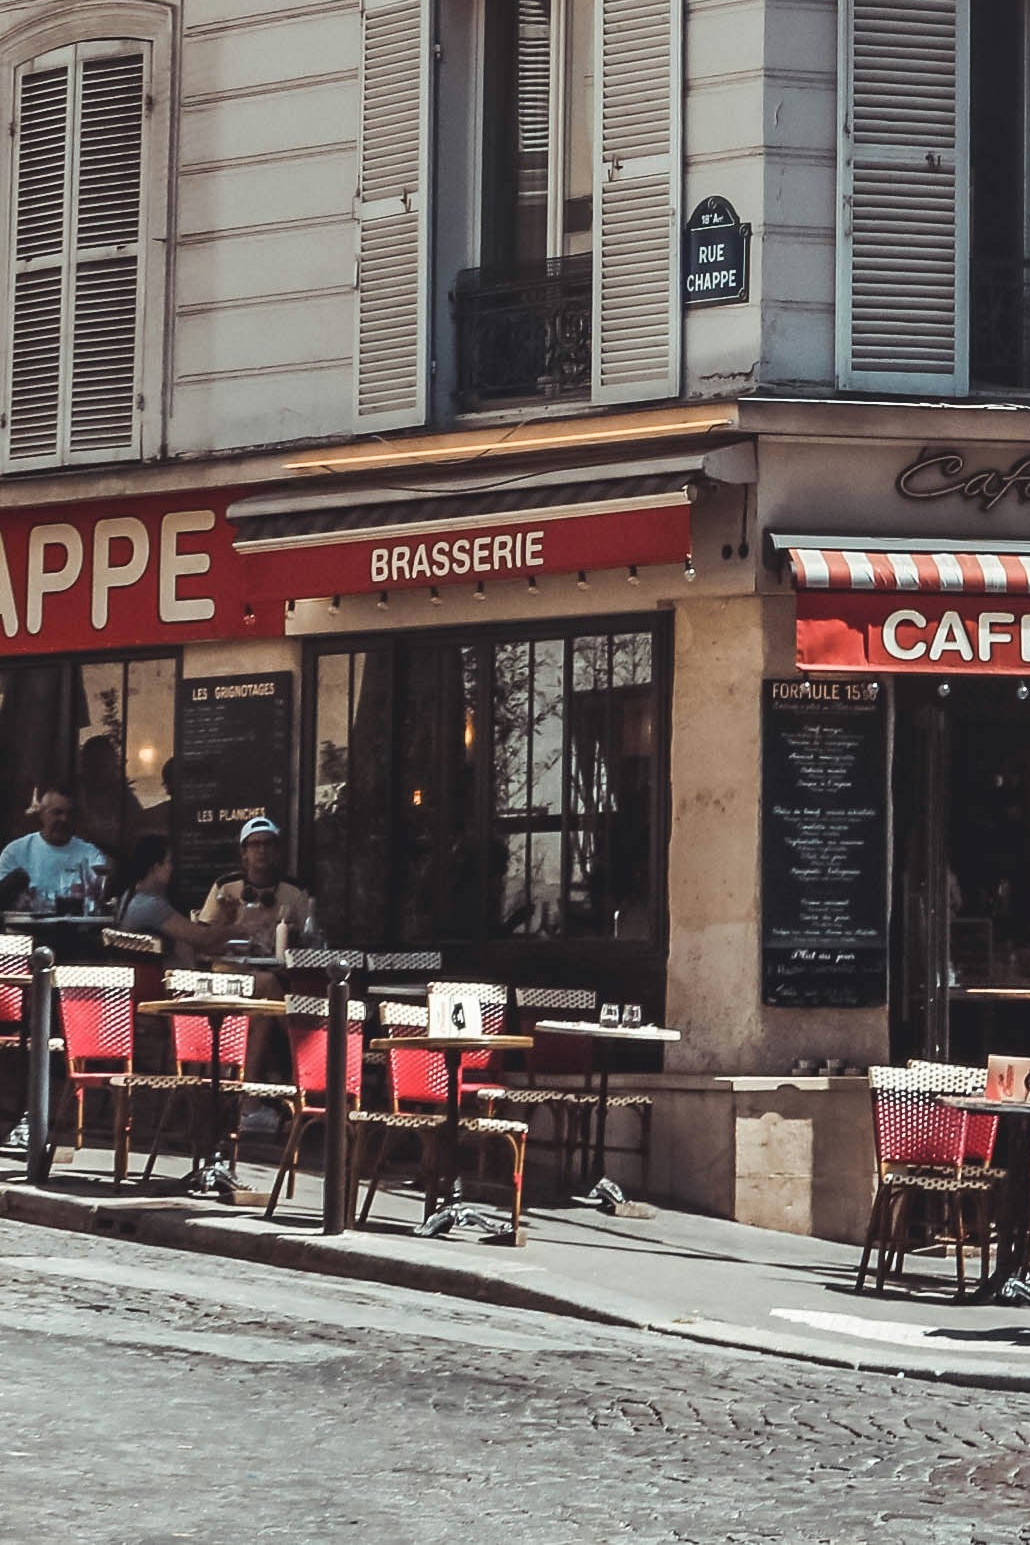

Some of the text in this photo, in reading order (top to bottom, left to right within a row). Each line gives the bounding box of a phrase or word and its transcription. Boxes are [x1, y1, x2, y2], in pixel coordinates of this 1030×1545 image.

[698, 243, 725, 264] RUE
[686, 269, 737, 292] CHAPPE
[370, 529, 545, 582] BRASSERIE
[0, 509, 216, 638] PPE
[772, 683, 841, 701] FORMULE
